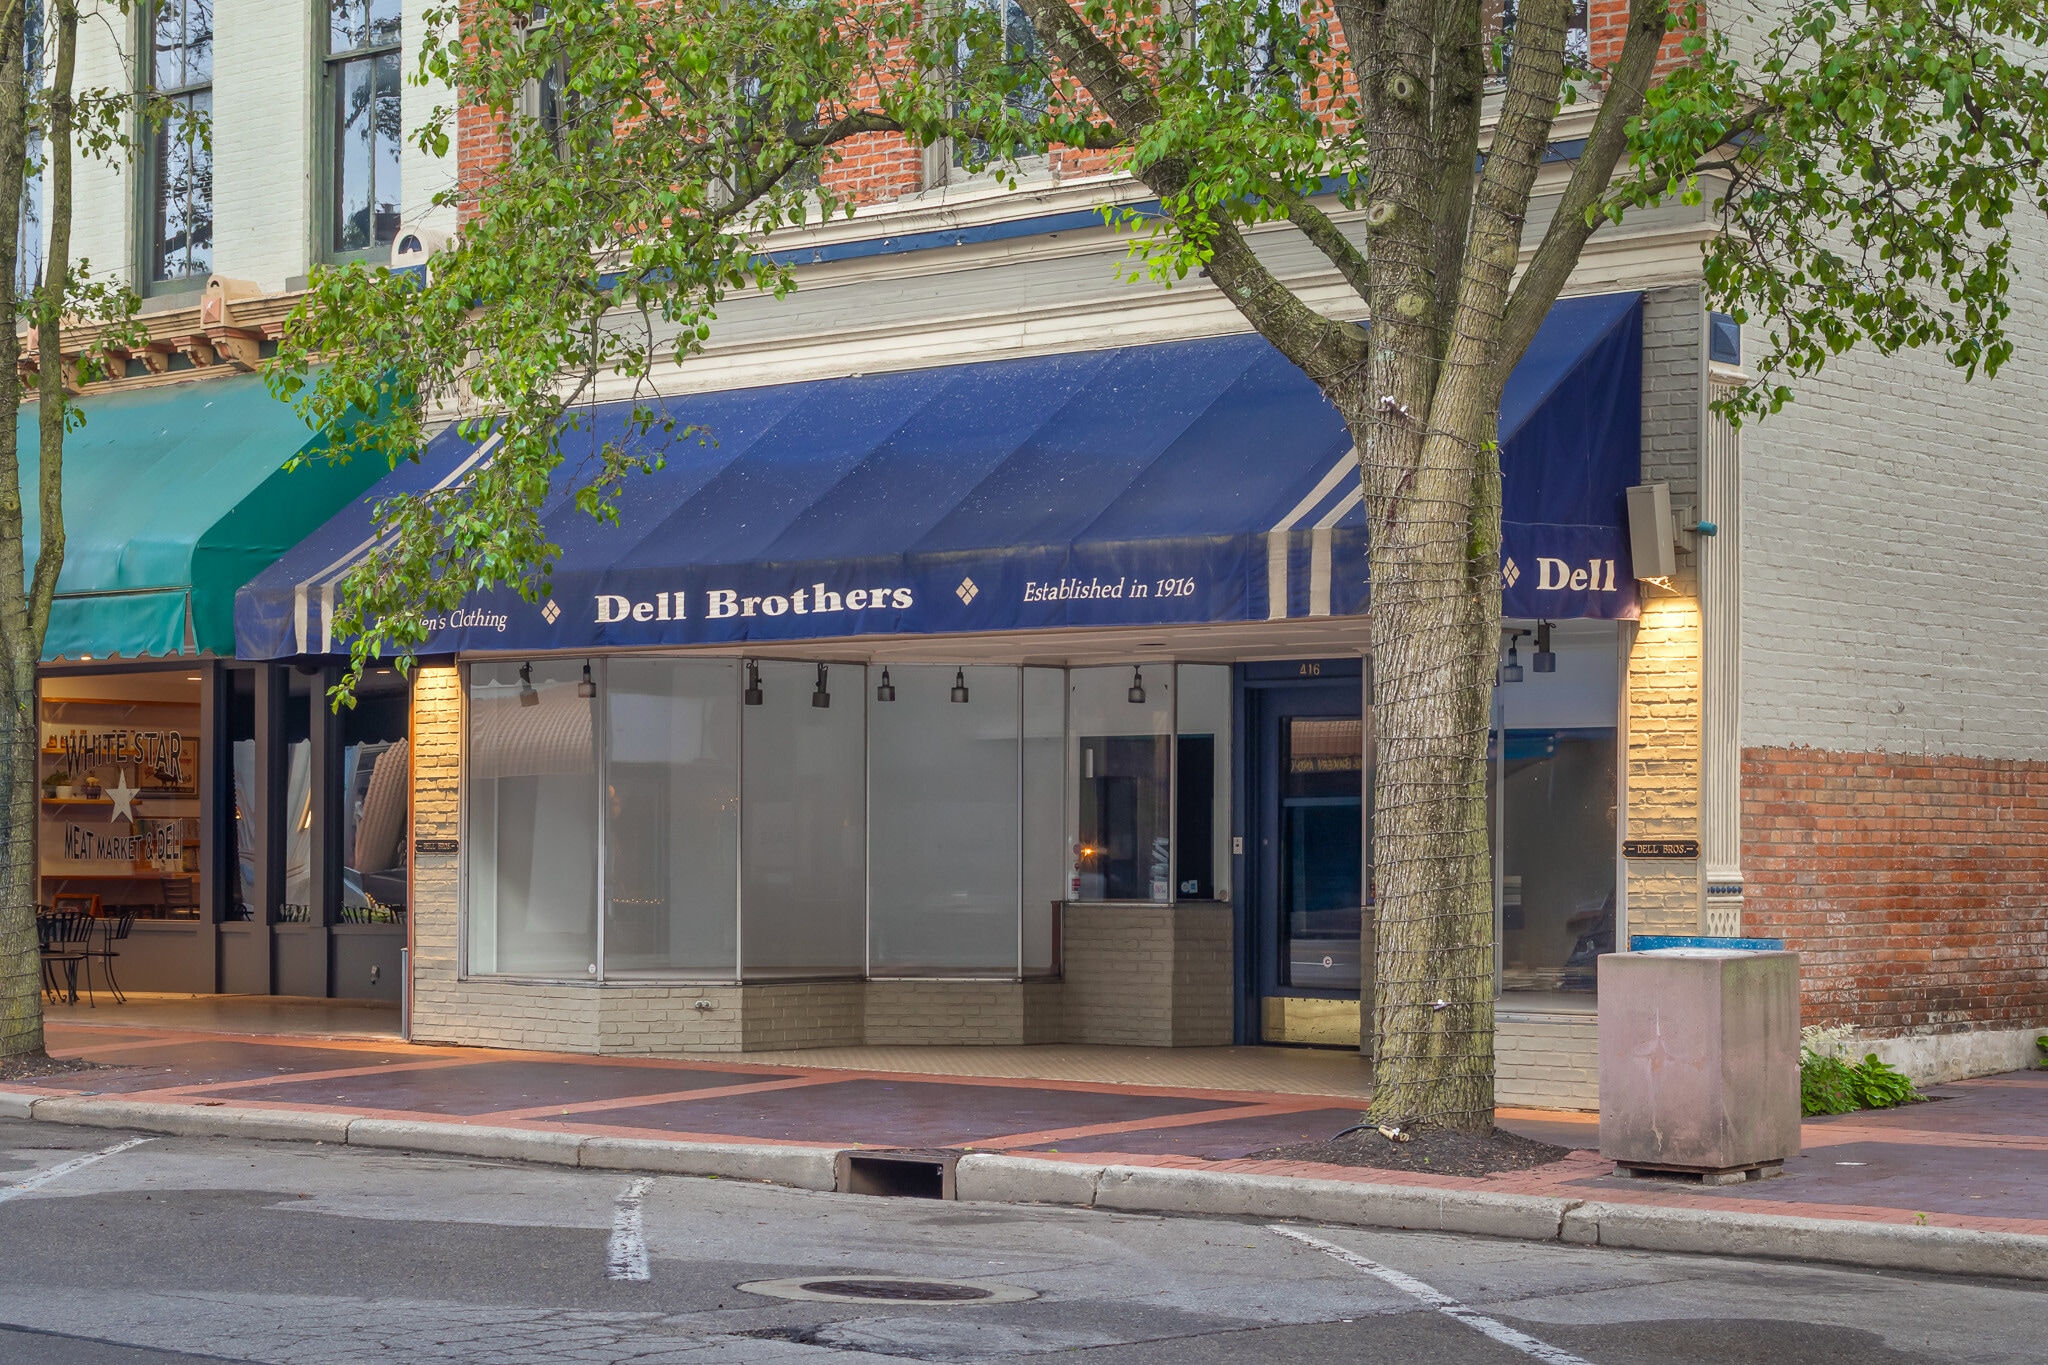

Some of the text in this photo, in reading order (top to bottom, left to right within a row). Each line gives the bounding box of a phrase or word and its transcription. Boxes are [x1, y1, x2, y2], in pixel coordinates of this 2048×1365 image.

[1023, 577, 1195, 602] Established in 1916
[1536, 557, 1617, 592] Dell
[594, 582, 914, 623] Dell Brothers
[418, 614, 446, 631] en's
[450, 608, 508, 632] Clothing
[1300, 663, 1320, 676] 416
[64, 730, 183, 783] WHITE STAR
[64, 817, 183, 861] MEAT MARKET & DELI
[1637, 844, 1687, 854] DELL BROS.
